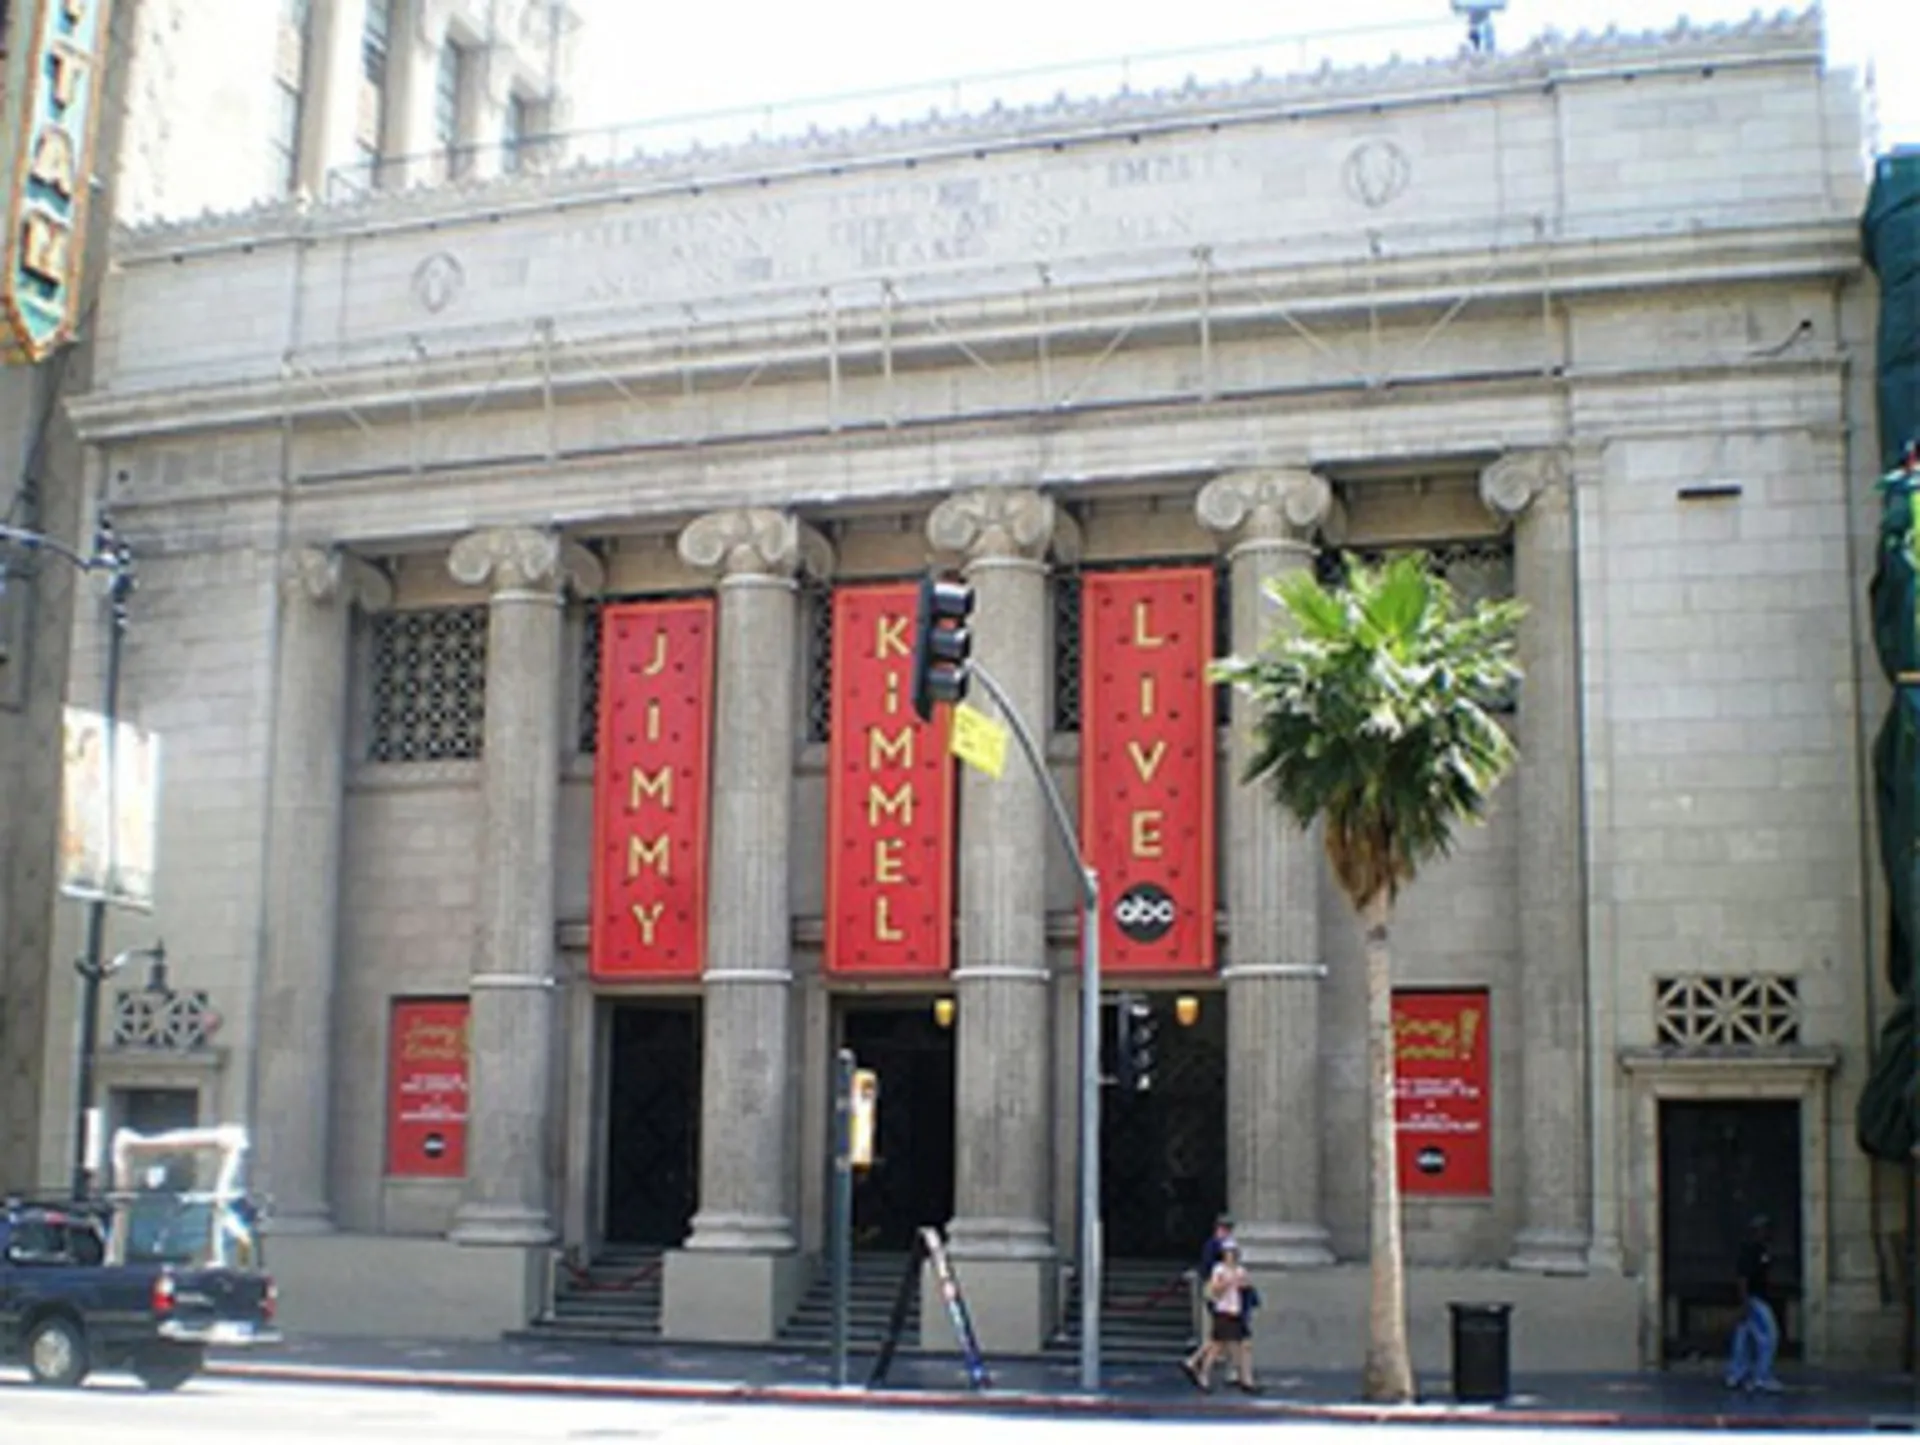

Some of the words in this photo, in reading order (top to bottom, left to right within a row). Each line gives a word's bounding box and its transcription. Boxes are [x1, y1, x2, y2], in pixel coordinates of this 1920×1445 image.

[626, 631, 675, 947] JIMMY
[867, 613, 915, 943] KIMMEL
[1127, 601, 1168, 858] LIVE
[1115, 893, 1176, 926] abc
